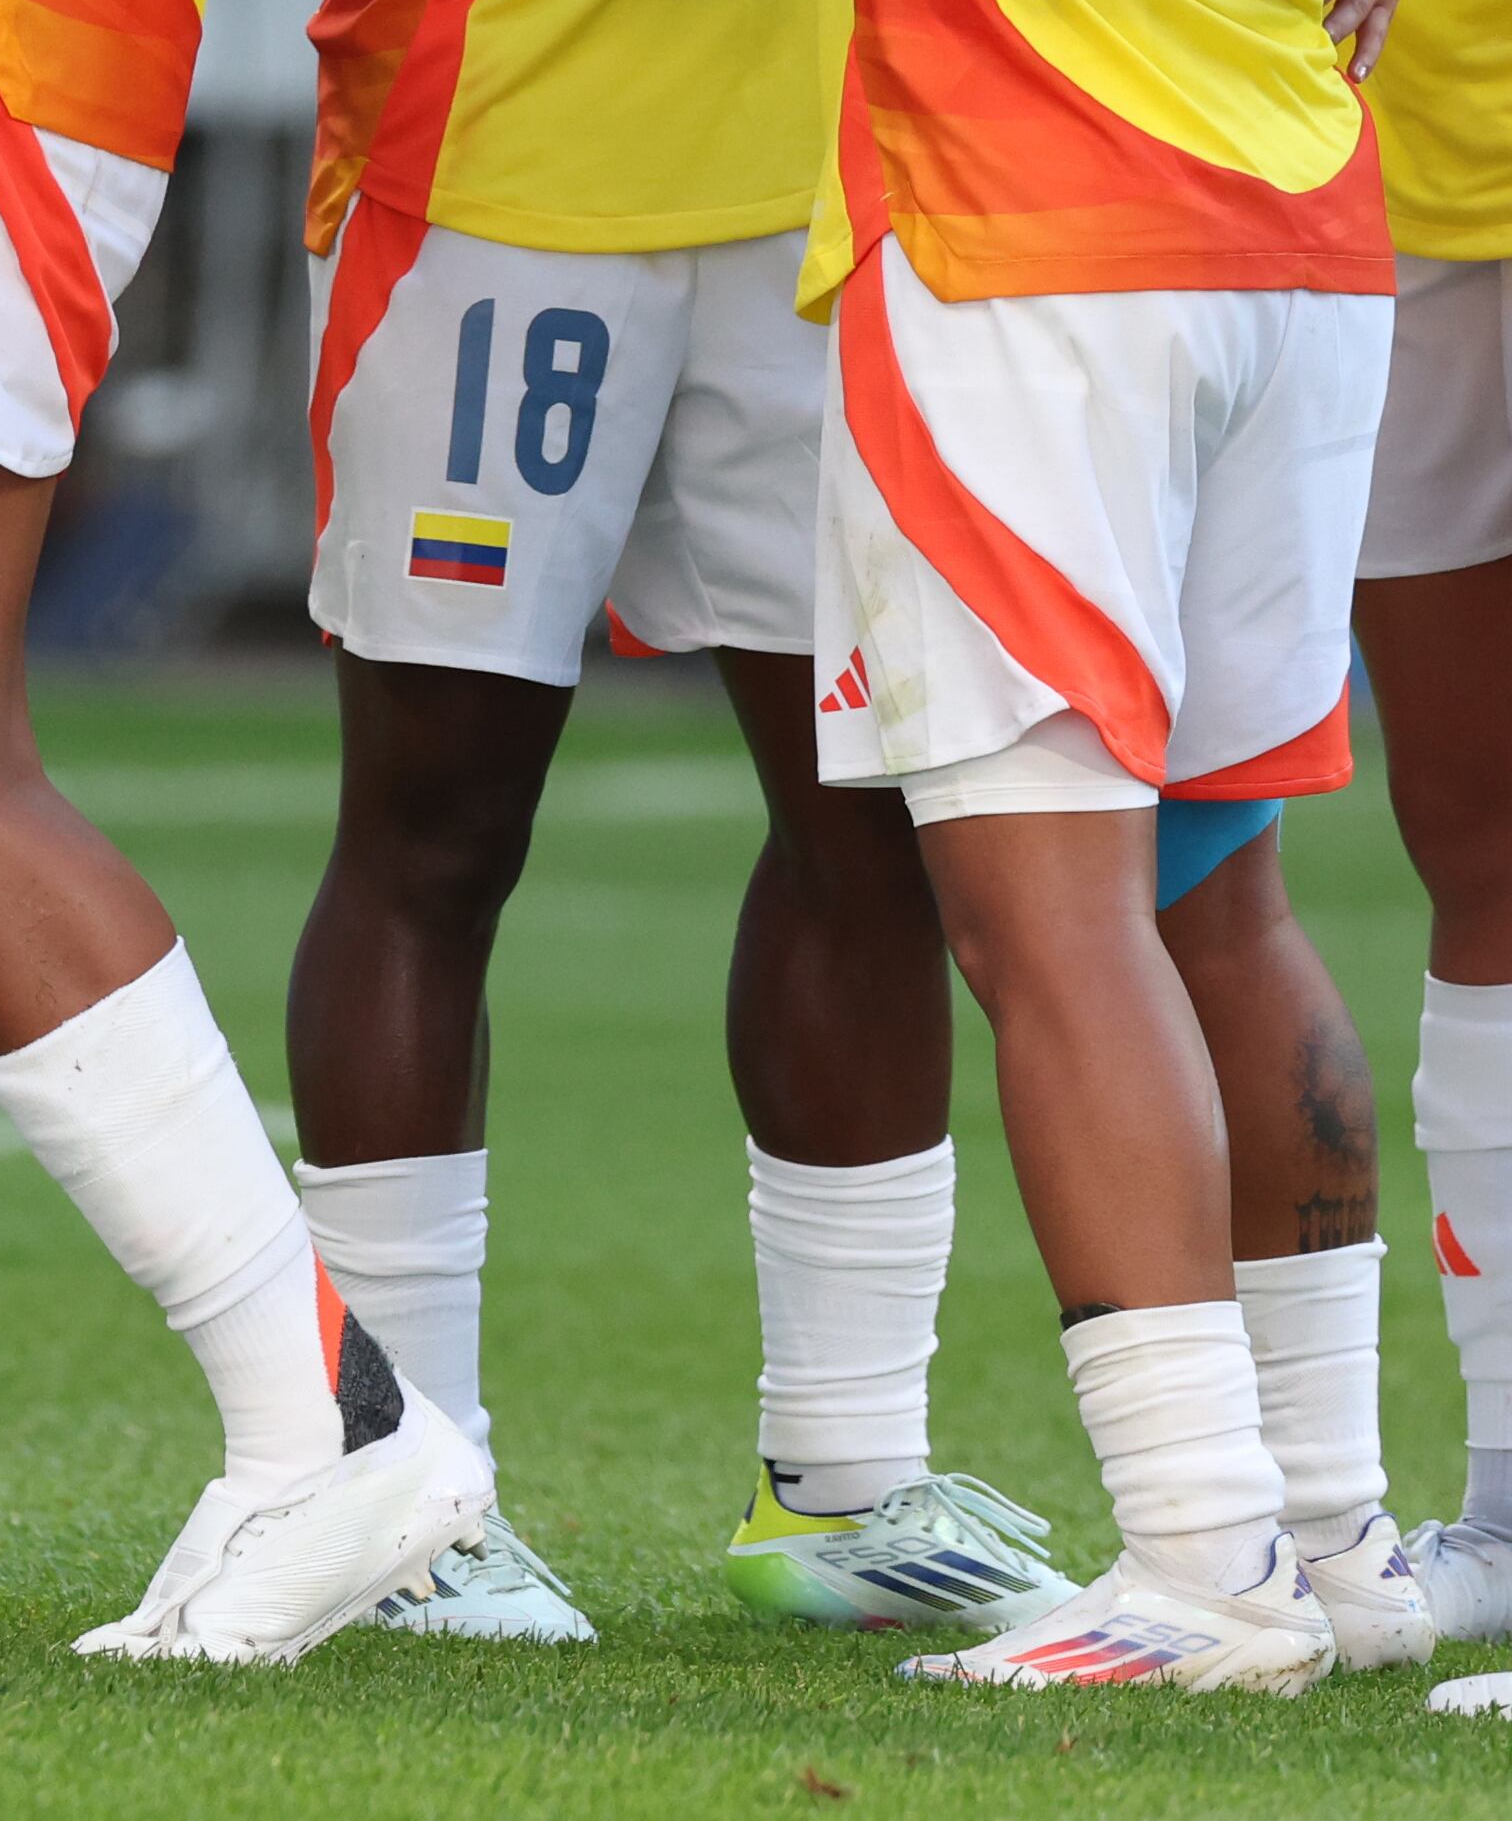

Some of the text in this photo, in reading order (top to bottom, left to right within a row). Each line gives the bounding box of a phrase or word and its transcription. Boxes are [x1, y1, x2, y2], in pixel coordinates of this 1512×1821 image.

[445, 297, 611, 497] 18
[815, 1536, 938, 1570] F50
[1099, 1613, 1222, 1653] F50
